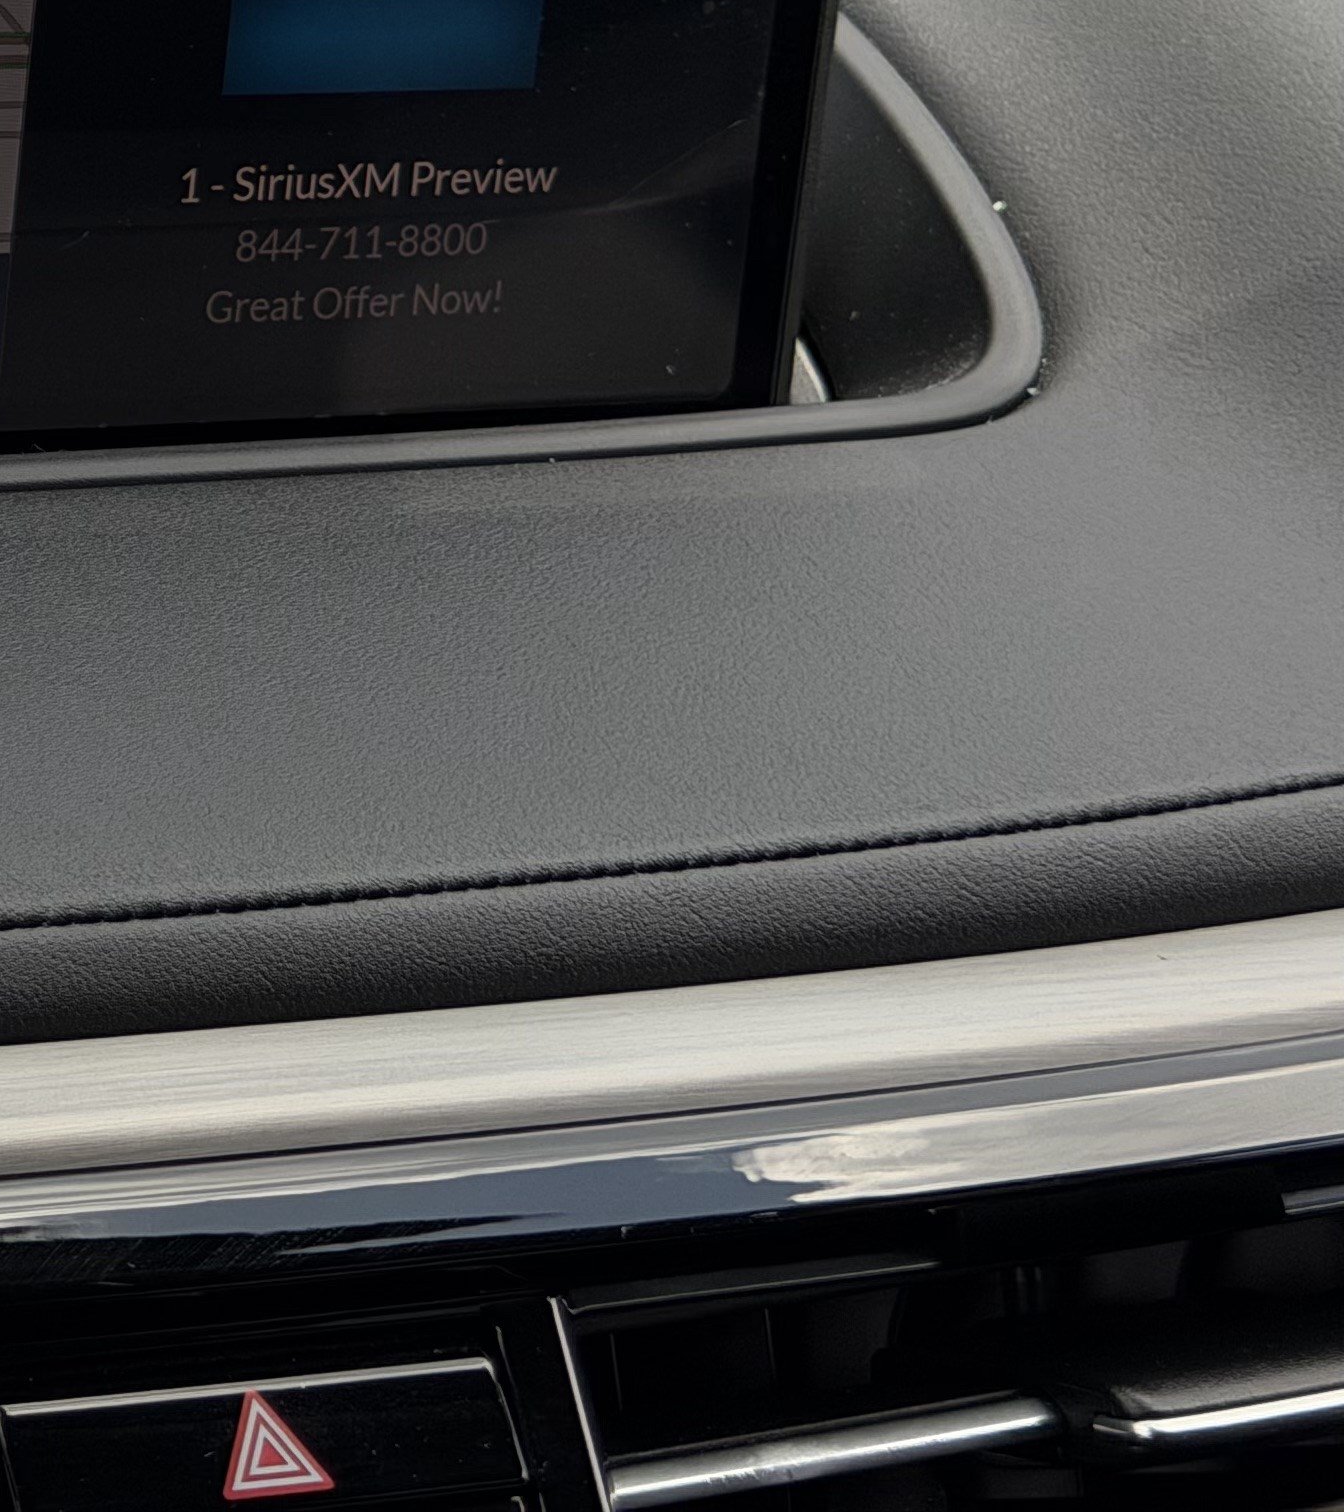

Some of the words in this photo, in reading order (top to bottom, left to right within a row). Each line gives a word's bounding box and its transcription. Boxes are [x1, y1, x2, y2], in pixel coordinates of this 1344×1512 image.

[233, 163, 402, 202] SiriusXM
[411, 158, 559, 196] Preview
[235, 222, 488, 263] 844-711-8800
[205, 288, 304, 324] Great
[313, 284, 405, 321] Offer
[412, 279, 504, 316] Now!
